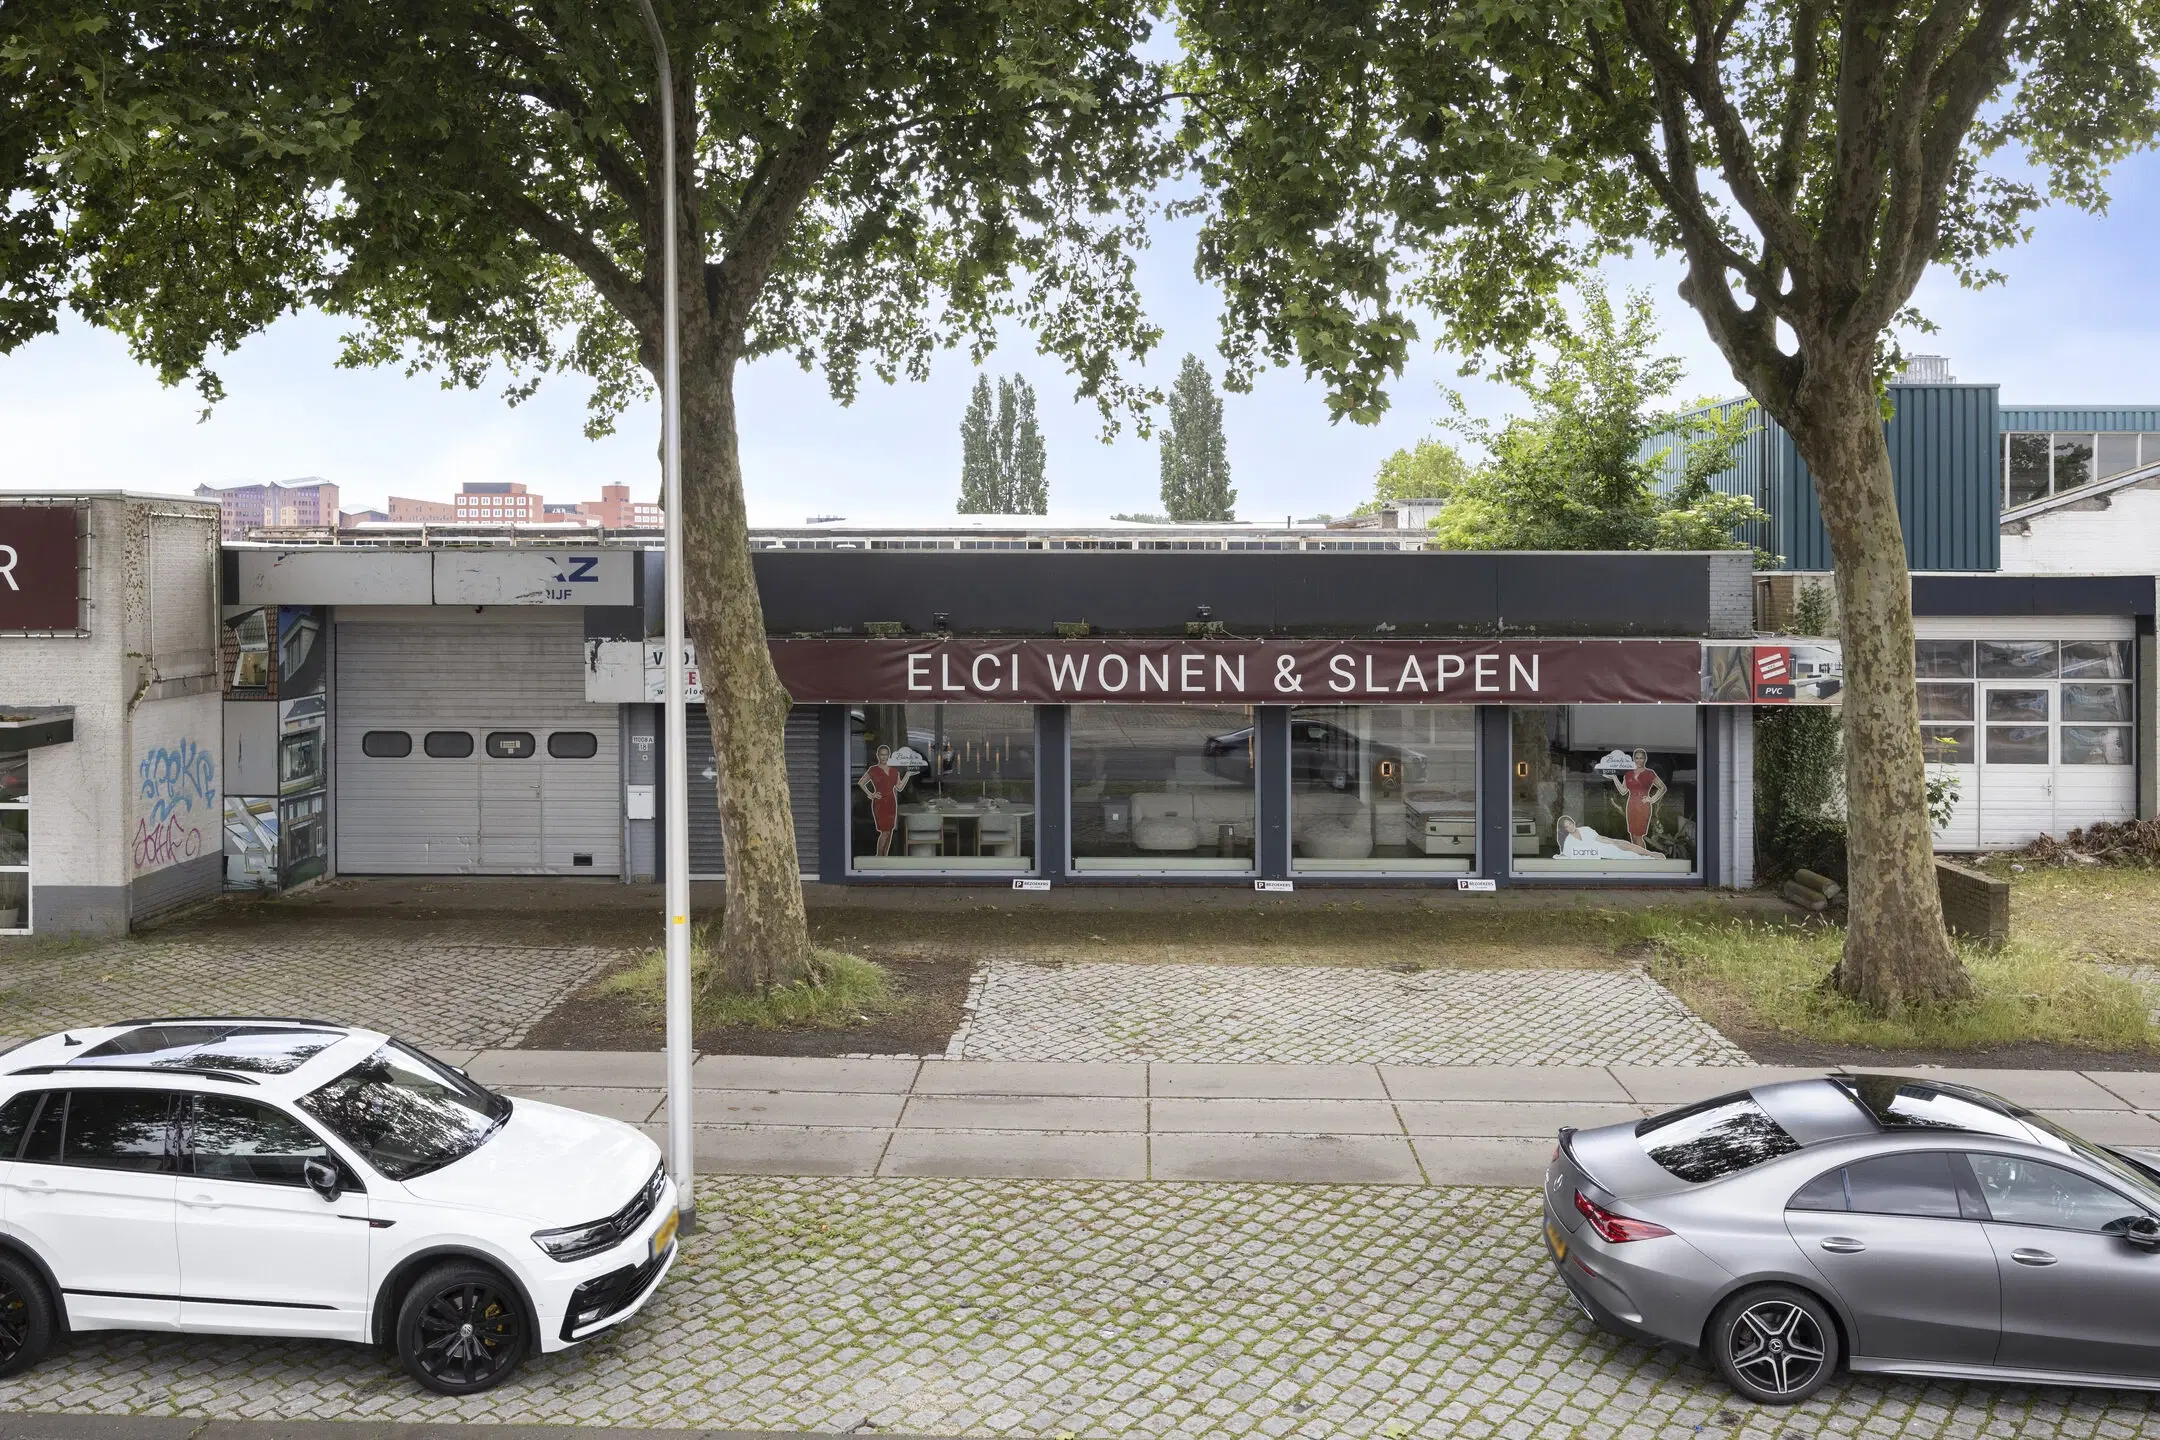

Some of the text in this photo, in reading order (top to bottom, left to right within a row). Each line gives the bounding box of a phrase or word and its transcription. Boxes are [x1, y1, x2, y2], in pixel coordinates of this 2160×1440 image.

[908, 653, 1539, 693] ELCI WONEN & SLAPEN
[1765, 687, 1783, 695] PVC
[1572, 847, 1599, 856] bambi
